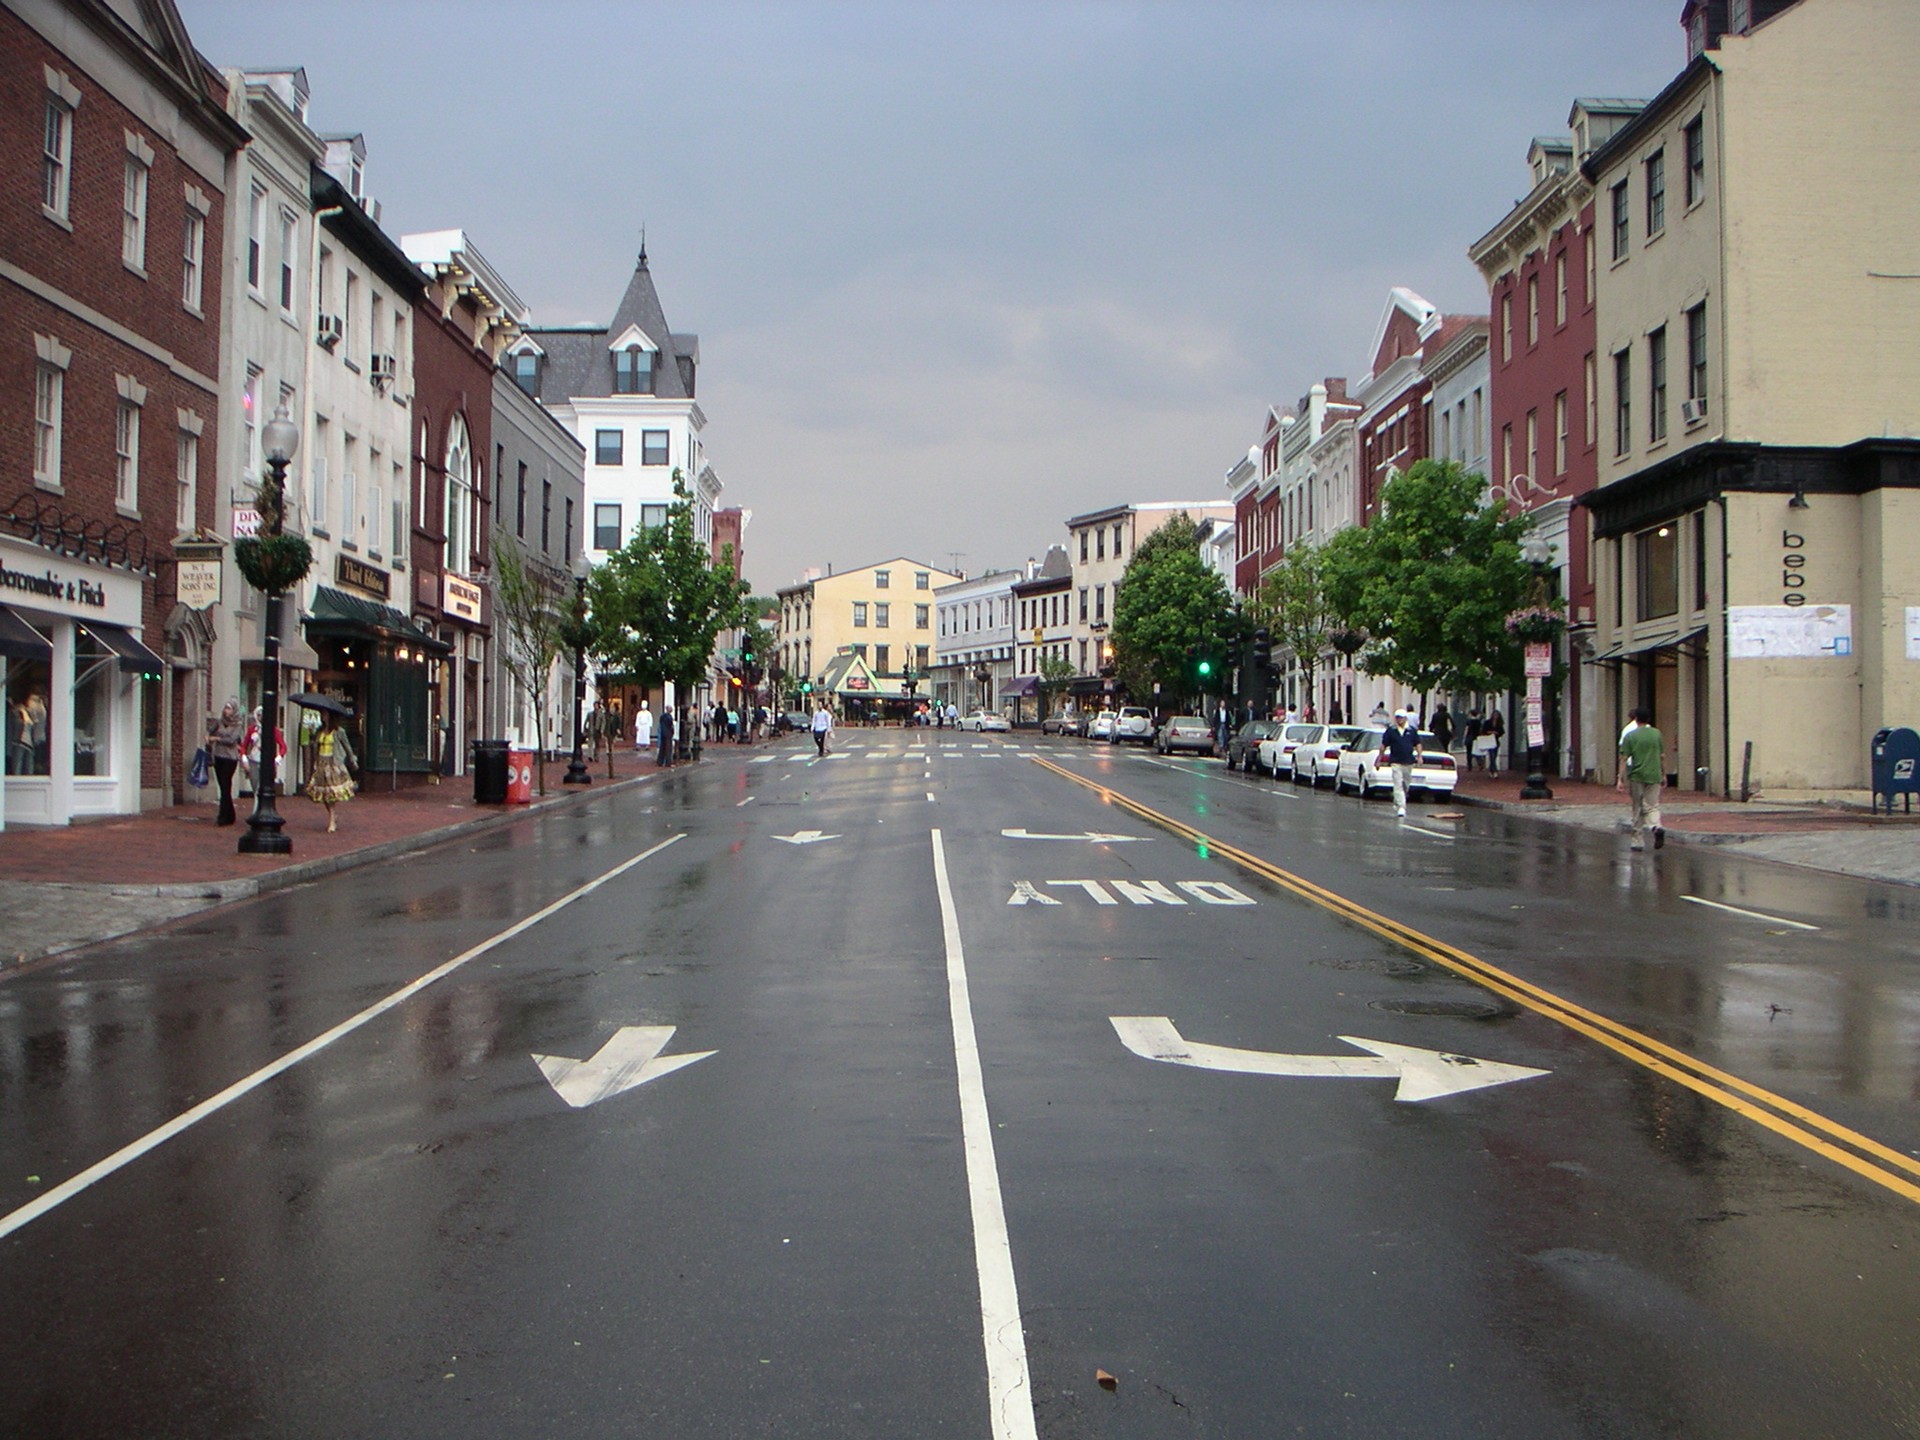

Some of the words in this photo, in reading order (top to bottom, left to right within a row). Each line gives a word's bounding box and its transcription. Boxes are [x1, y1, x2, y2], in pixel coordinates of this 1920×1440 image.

[240, 512, 259, 521] DIV
[344, 560, 362, 585] Third
[364, 567, 384, 593] Edition
[1783, 530, 1805, 606] bebe
[0, 558, 64, 599] bercrombie
[66, 582, 76, 601] &
[79, 578, 105, 607] Fitch
[181, 582, 200, 591] SONS
[302, 713, 322, 728] SAL
[1007, 880, 1257, 906] ONLY
